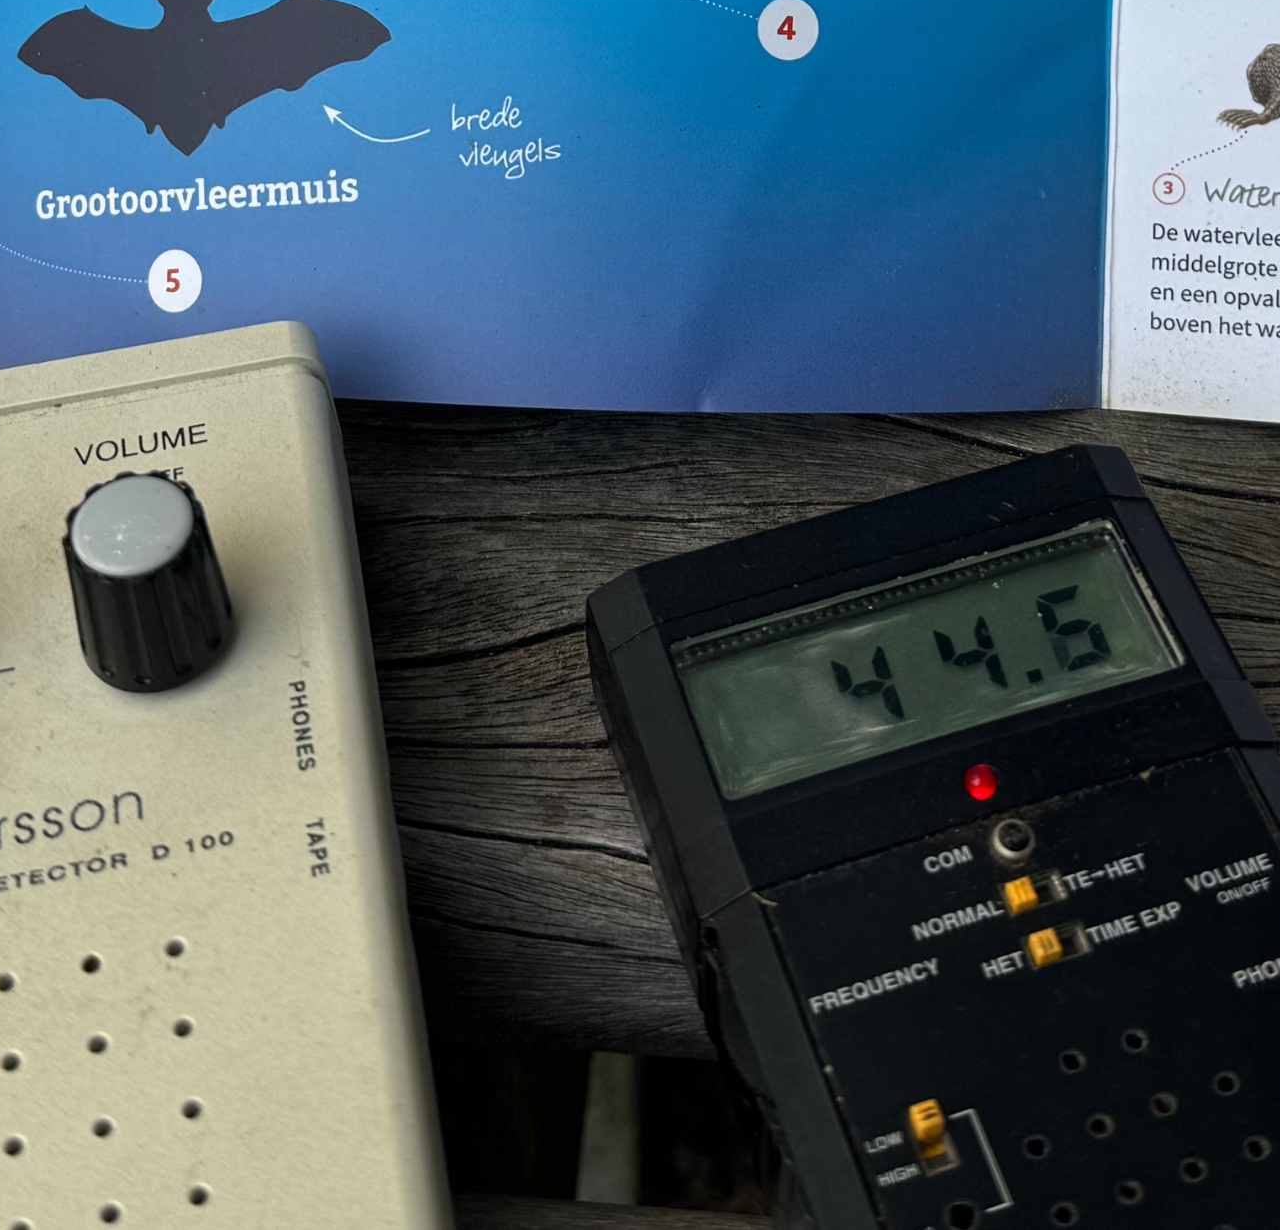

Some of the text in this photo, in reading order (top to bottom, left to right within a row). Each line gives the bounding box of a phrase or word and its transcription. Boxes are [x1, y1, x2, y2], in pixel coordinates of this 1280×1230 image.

[777, 15, 796, 40] 4
[452, 96, 522, 130] brede
[459, 138, 561, 179] vleugels
[36, 170, 358, 219] Grootoorvleermuis
[1164, 181, 1173, 194] 3
[1153, 223, 1178, 241] De
[166, 268, 180, 293] 5
[74, 423, 207, 465] VOLUME
[289, 681, 316, 771] PHONES
[152, 844, 170, 860] D
[185, 831, 234, 853] 100
[306, 818, 330, 877] TAPE
[924, 846, 973, 873] COM
[1185, 852, 1275, 894] VOLUME
[912, 852, 1146, 941] NORMAL TE-HET
[1216, 877, 1272, 904] ON/OFF
[981, 901, 1182, 979] HET TIME EXP
[809, 958, 938, 1013] FREQUENCY
[865, 1131, 903, 1153] LOW
[877, 1164, 920, 1186] HIGH
